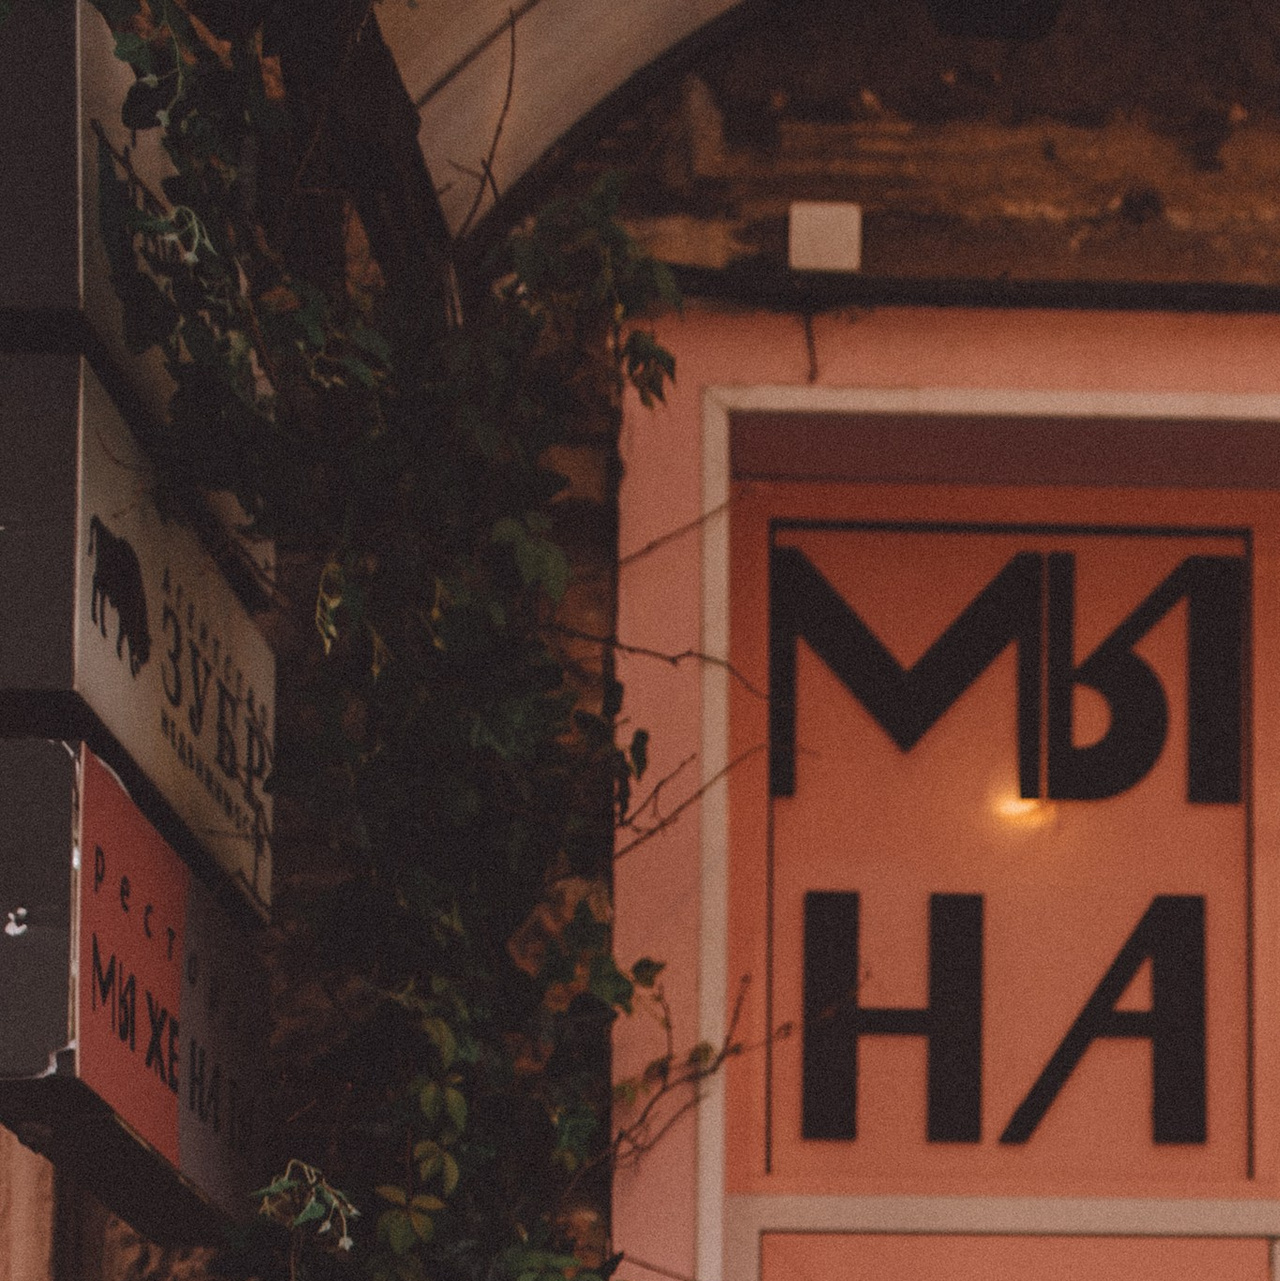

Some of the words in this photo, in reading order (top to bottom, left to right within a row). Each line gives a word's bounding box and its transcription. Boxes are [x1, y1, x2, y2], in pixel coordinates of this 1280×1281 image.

[161, 606, 267, 794] ЗУБР
[770, 545, 1244, 803] МЫ
[92, 932, 137, 1052] МЫ
[145, 990, 181, 1096] ЖЕ
[800, 889, 1207, 1145] НА
